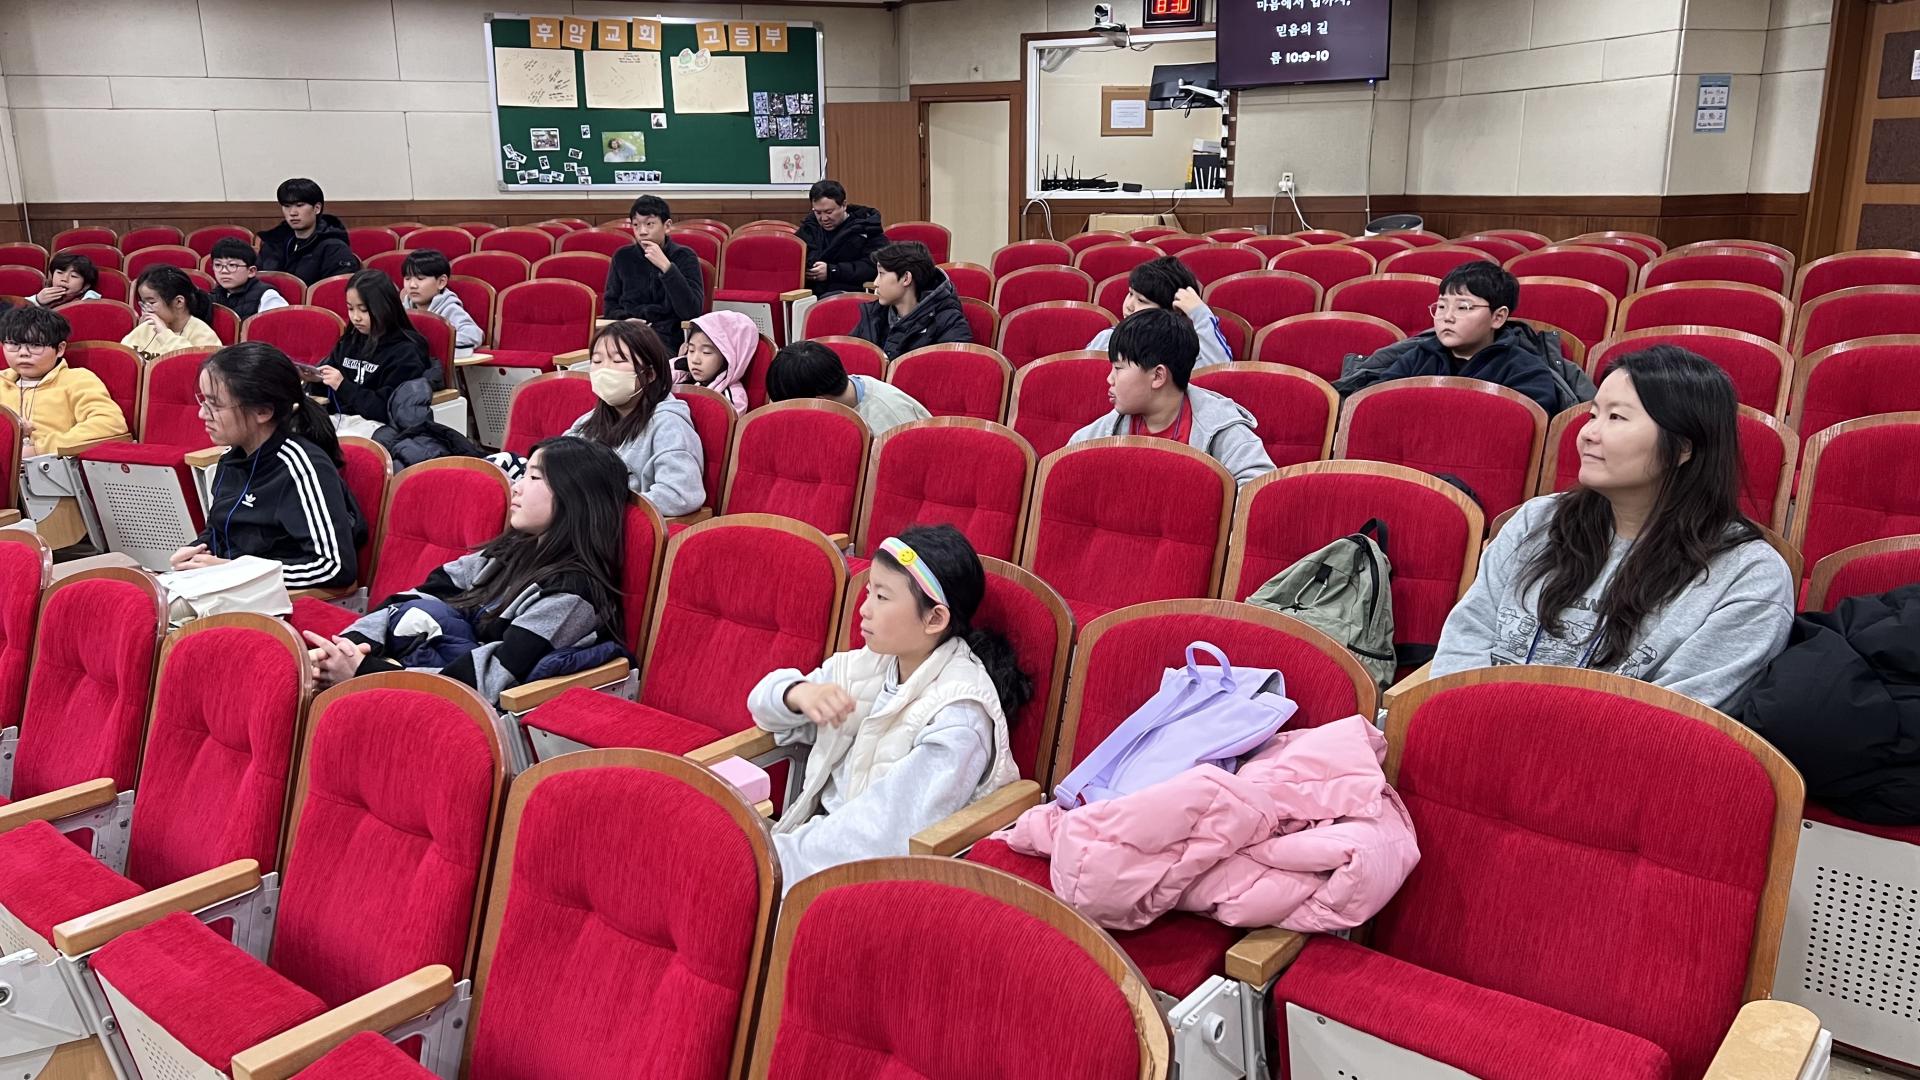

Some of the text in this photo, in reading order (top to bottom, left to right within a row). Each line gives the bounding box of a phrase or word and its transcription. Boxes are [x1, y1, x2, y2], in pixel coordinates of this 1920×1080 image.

[1256, 0, 1304, 12] 마음에서
[536, 23, 782, 47] 후암교회 고등부
[1276, 20, 1329, 37] 믿음의 길
[1286, 50, 1330, 63] 10:9-10
